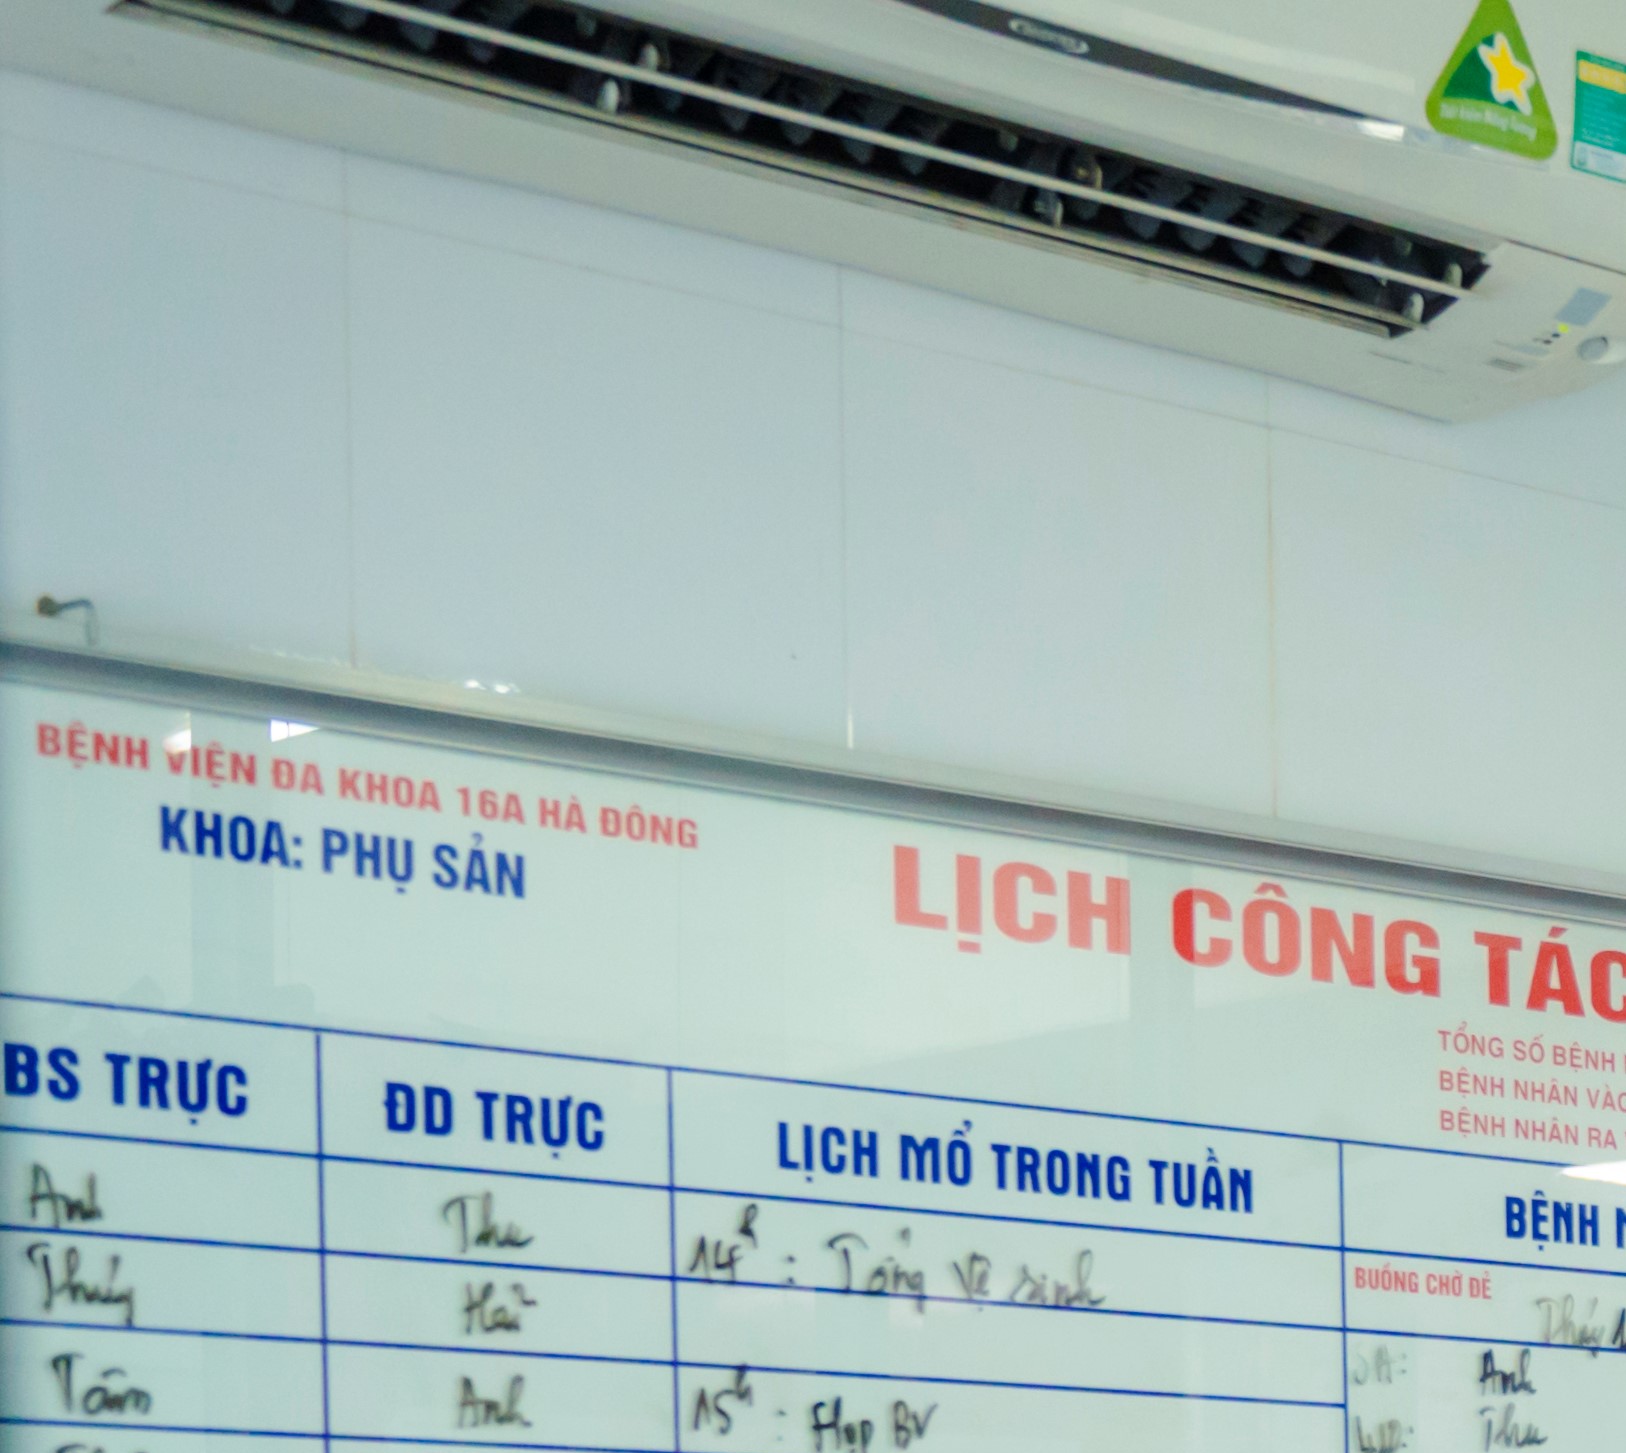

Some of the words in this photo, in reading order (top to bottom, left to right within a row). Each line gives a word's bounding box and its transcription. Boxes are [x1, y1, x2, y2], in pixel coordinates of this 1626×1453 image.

[37, 722, 149, 770] BỆNH
[166, 741, 257, 786] VIỆN
[270, 757, 324, 796] ĐA
[338, 768, 441, 812] KHOA
[457, 786, 525, 824] 16A
[538, 793, 587, 833] HÀ
[599, 802, 699, 849] ĐÔNG
[160, 806, 301, 868] KHOA:
[322, 828, 414, 893] PHỤ
[433, 833, 525, 898] SẢN
[893, 842, 1133, 955] LỊCH
[1171, 879, 1442, 997] CÔNG
[3, 1042, 80, 1101] BS
[104, 1053, 247, 1124] TRỰC
[1437, 1021, 1505, 1059] TỔNG
[1512, 1035, 1546, 1064] SỐ
[1552, 1042, 1616, 1072] BỆNH
[384, 1082, 453, 1136] ĐD
[475, 1091, 604, 1158] TRỰC
[1439, 1067, 1505, 1098] BỆNH
[1513, 1078, 1578, 1107] NHÂN
[1439, 1106, 1506, 1137] BỆNH
[1513, 1117, 1579, 1145] NHÂN
[1587, 1126, 1617, 1150] RA
[778, 1122, 878, 1182] LỊCH
[900, 1120, 972, 1186] MỔ
[991, 1143, 1130, 1201] TRONG
[1148, 1148, 1252, 1213] TUẦN
[1505, 1190, 1599, 1250] BỆNH
[1425, 1270, 1463, 1297] CHỜ
[1468, 1271, 1491, 1300] ĐẺ
